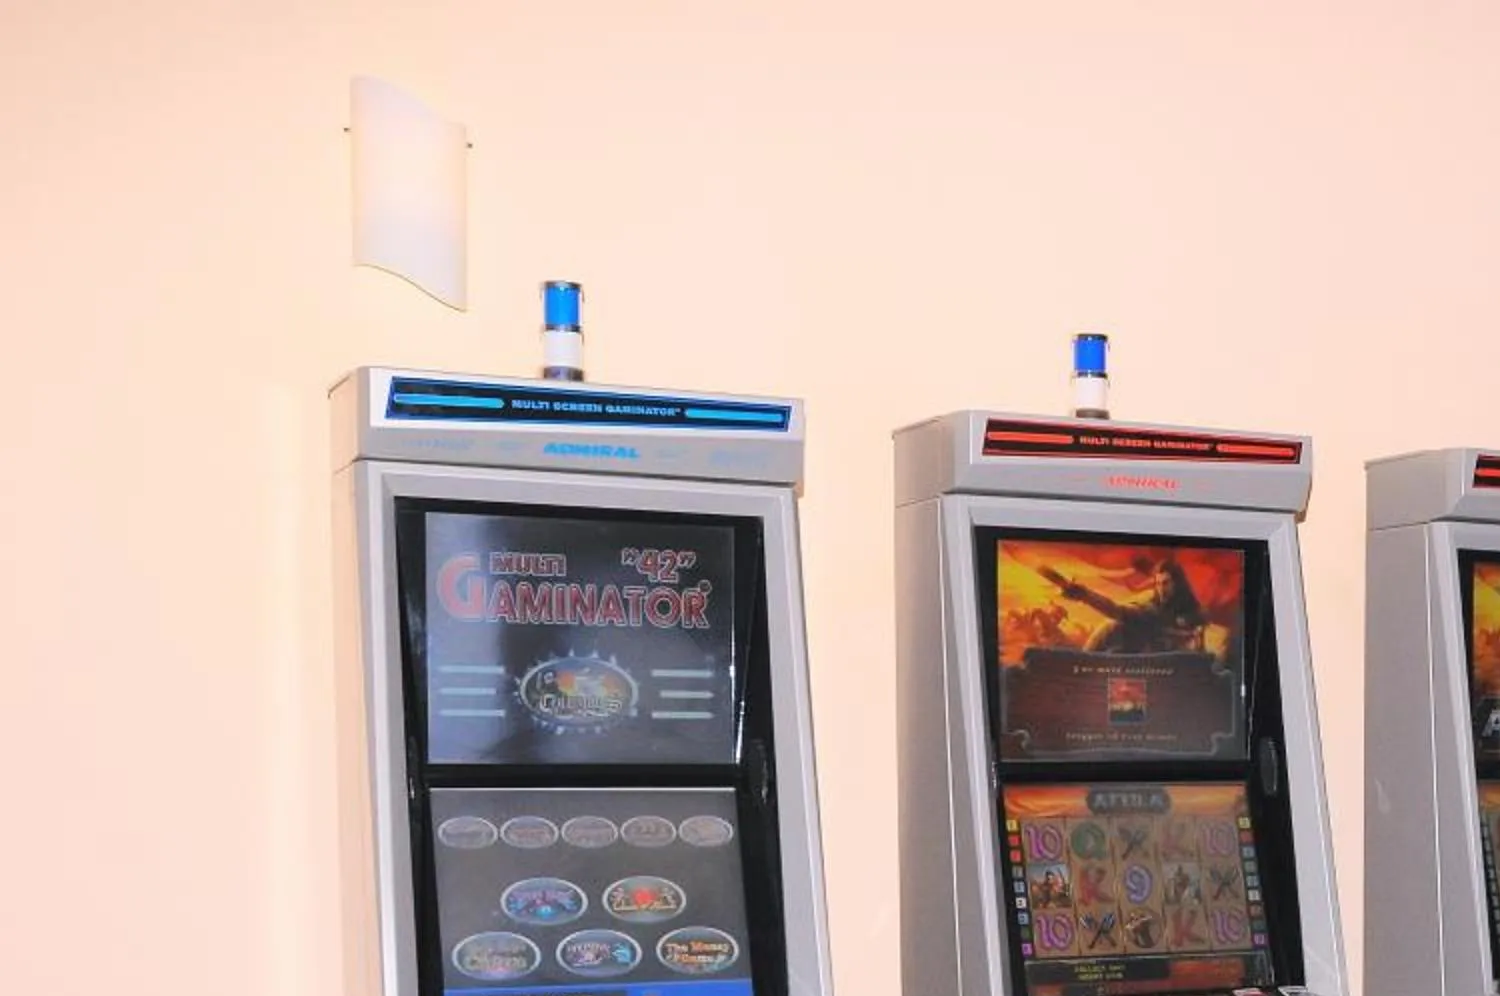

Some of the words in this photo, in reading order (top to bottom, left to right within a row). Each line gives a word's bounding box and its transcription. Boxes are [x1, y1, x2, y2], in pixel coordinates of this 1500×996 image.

[511, 400, 549, 410] MULTI
[553, 402, 602, 412] SCREEN
[543, 442, 640, 460] ADMIRAL
[489, 552, 567, 577] MULTI
[436, 553, 711, 628] GAMINATOR
